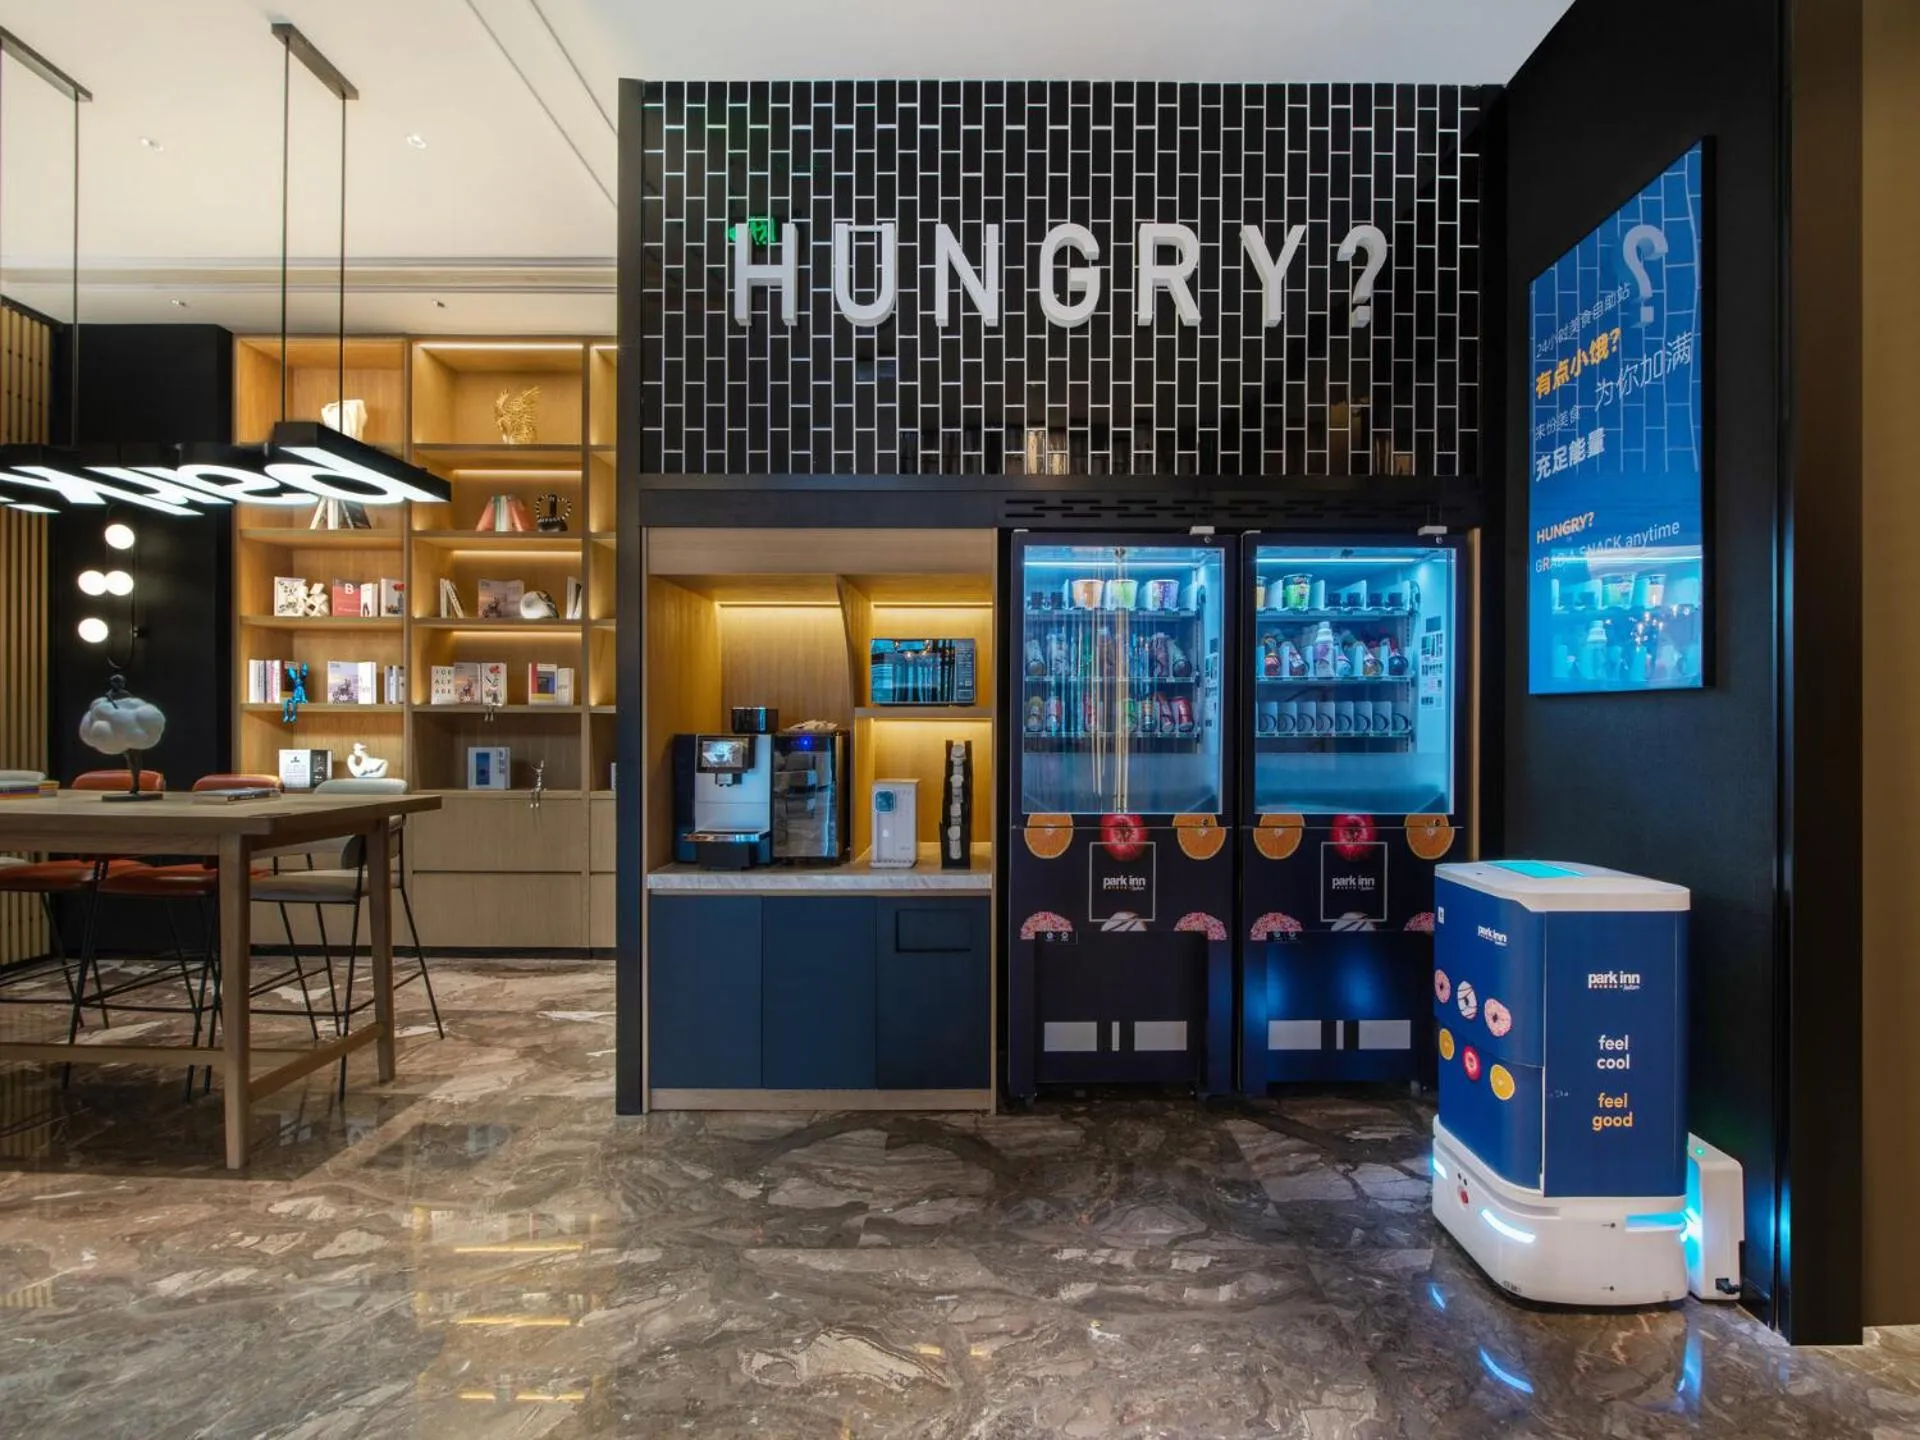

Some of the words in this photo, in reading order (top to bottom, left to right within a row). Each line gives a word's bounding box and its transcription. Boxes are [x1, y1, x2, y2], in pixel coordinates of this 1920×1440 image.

[734, 222, 1388, 328] HUNGRY?
[1595, 330, 1692, 412] 为你加满
[1535, 427, 1606, 482] 充足能量
[1536, 511, 1595, 544] HUNGRY?
[1625, 521, 1680, 553] anytime
[344, 583, 354, 595] B
[1103, 875, 1127, 890] park
[1128, 875, 1146, 887] inn
[1332, 875, 1356, 890] park
[1358, 875, 1375, 887] inn
[1588, 972, 1618, 989] park
[1620, 971, 1641, 985] inn
[1598, 1034, 1629, 1051] feel
[1596, 1053, 1630, 1070] cool
[1598, 1092, 1629, 1108] feel
[1592, 1111, 1633, 1131] good
